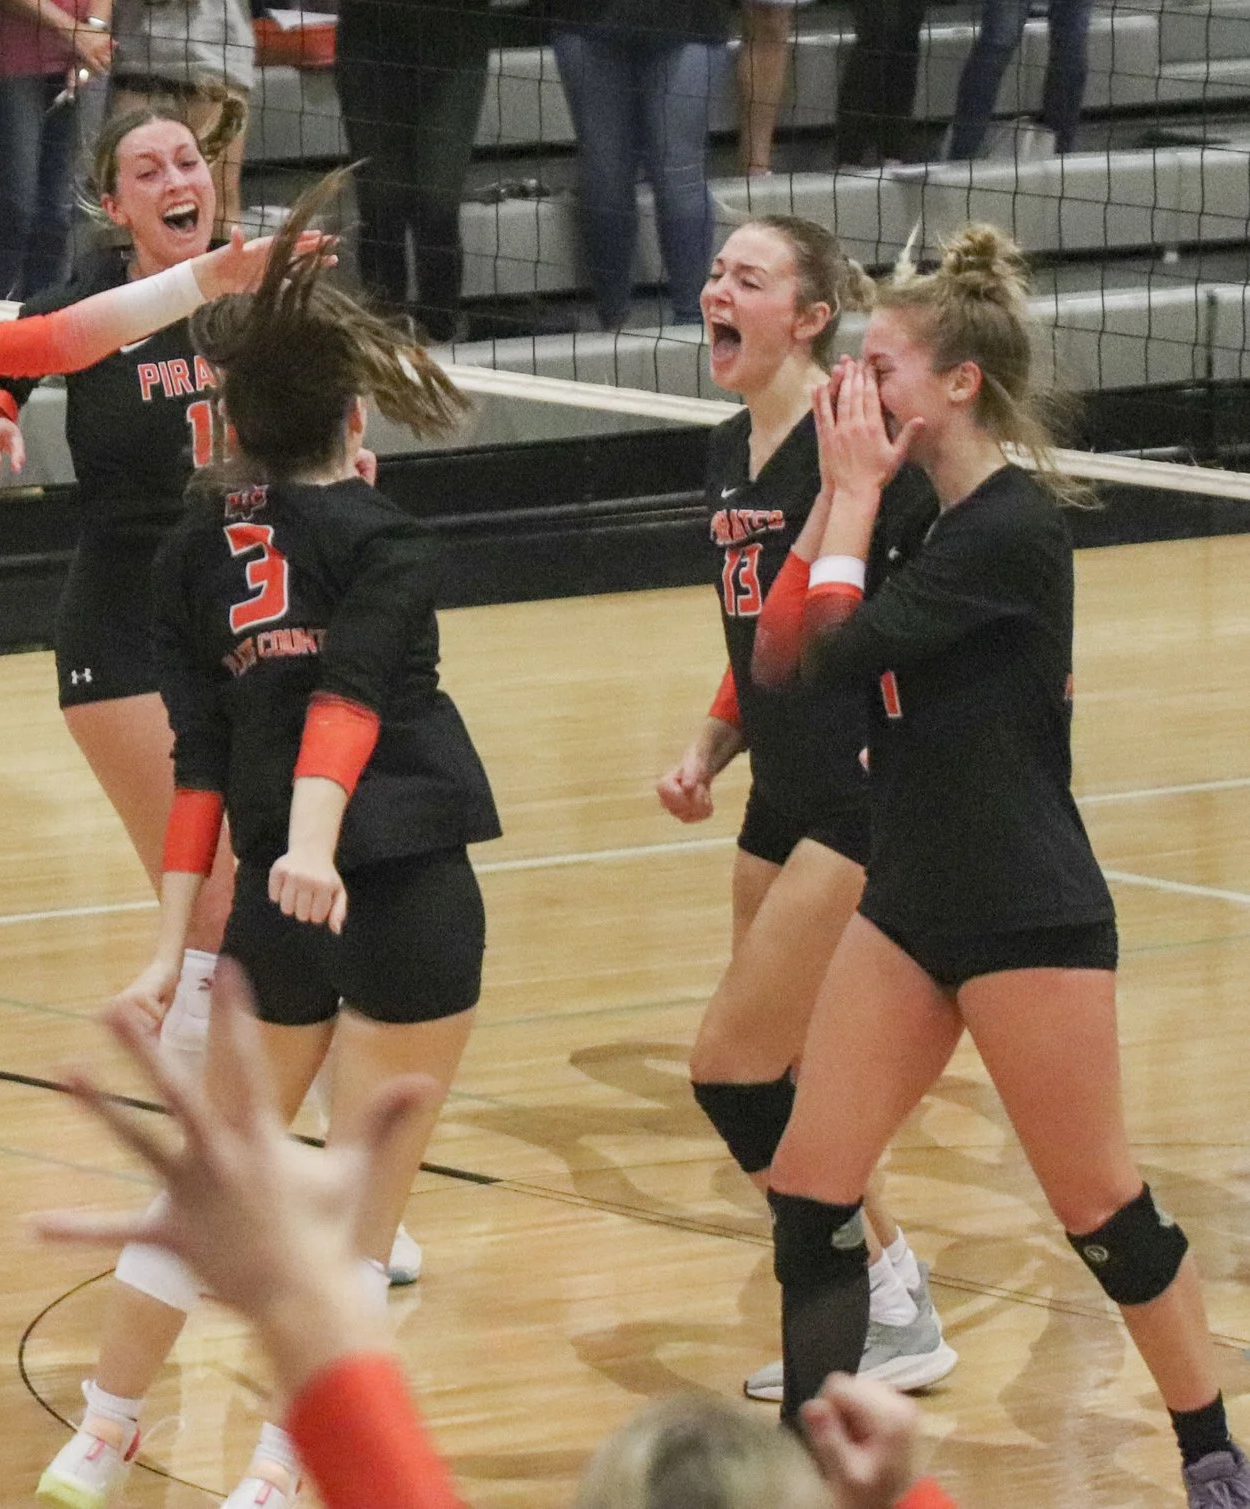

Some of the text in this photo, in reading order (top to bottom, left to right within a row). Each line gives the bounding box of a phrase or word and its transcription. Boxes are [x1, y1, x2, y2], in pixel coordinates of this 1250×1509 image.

[137, 355, 224, 401] PIRA
[223, 522, 289, 634] 3
[722, 543, 763, 616] 13
